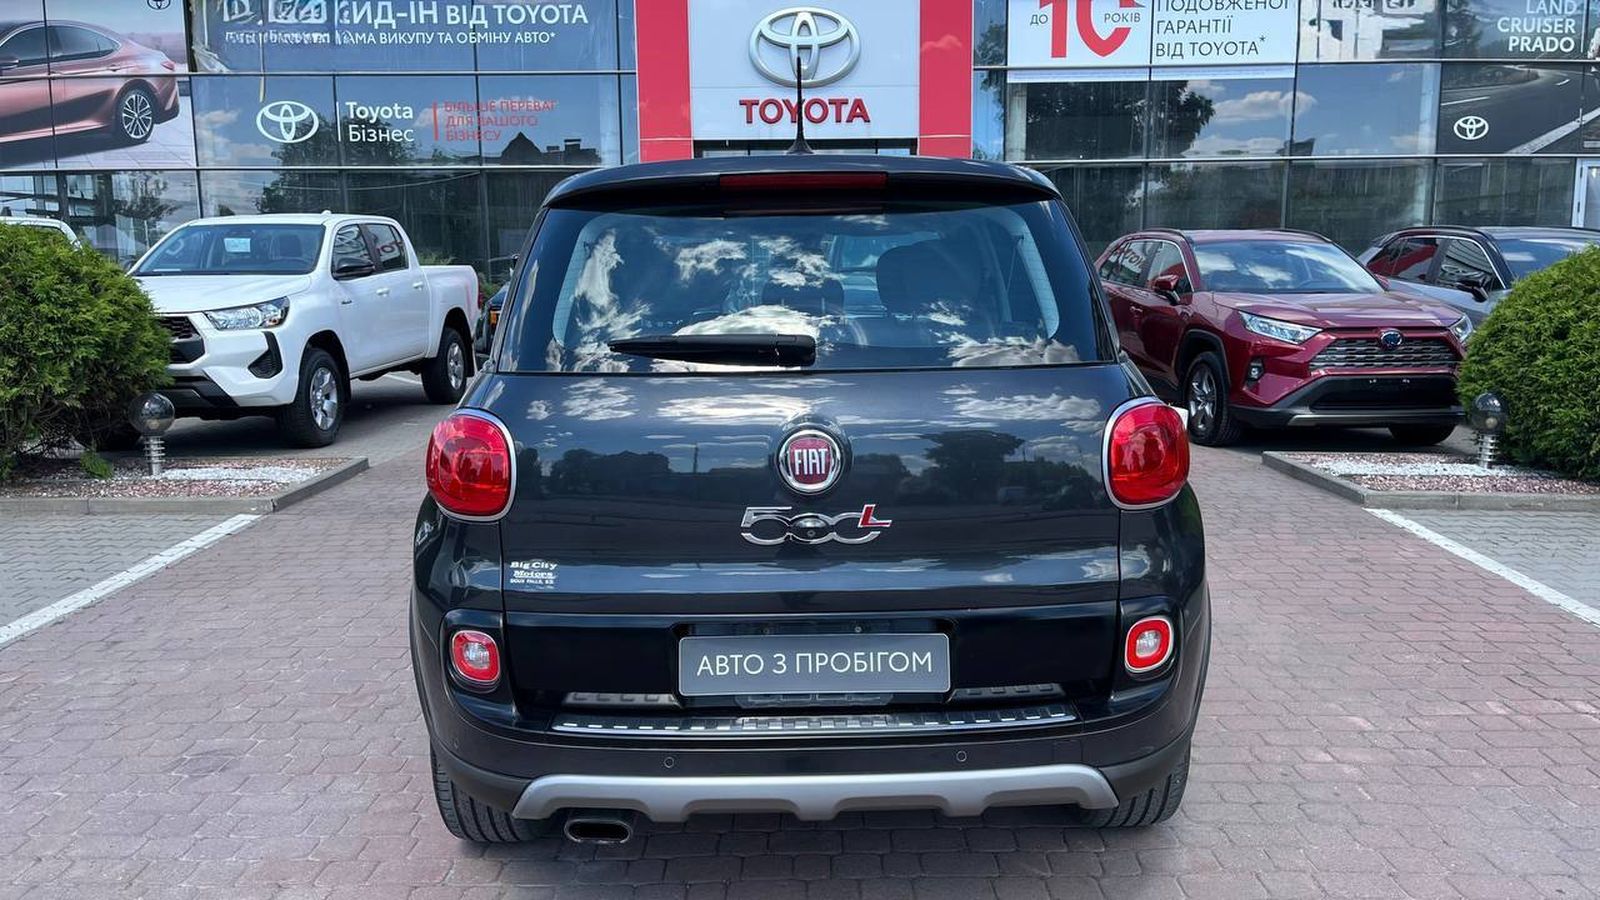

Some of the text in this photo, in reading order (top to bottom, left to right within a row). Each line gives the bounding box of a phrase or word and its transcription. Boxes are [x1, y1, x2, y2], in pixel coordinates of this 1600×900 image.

[1526, 0, 1577, 15] LAND
[446, 5, 488, 29] ВІД
[493, 5, 589, 24] TOYOTA
[1030, 14, 1048, 26] ДО
[1104, 12, 1141, 23] РОКІВ
[1157, 15, 1232, 35] ГАРАНТІЇ
[1497, 17, 1576, 34] CRUISER
[380, 32, 434, 44] ВИКУПУ
[437, 32, 453, 44] ТА
[456, 32, 511, 44] ОБМІНУ
[1508, 36, 1575, 53] PRADO
[1155, 43, 1184, 59] ВІД
[345, 101, 414, 124] Toyota
[500, 100, 556, 112] ПЕРЕВАГ
[739, 98, 871, 125] TOYOTA
[446, 115, 473, 128] ДЛЯ
[349, 124, 414, 143] Бізнес
[793, 448, 829, 475] FIAT
[741, 504, 892, 545] 500L
[510, 561, 558, 570] Big City
[513, 570, 556, 579] Motors
[697, 651, 932, 676] АВТО З ПРОБІГОМ
